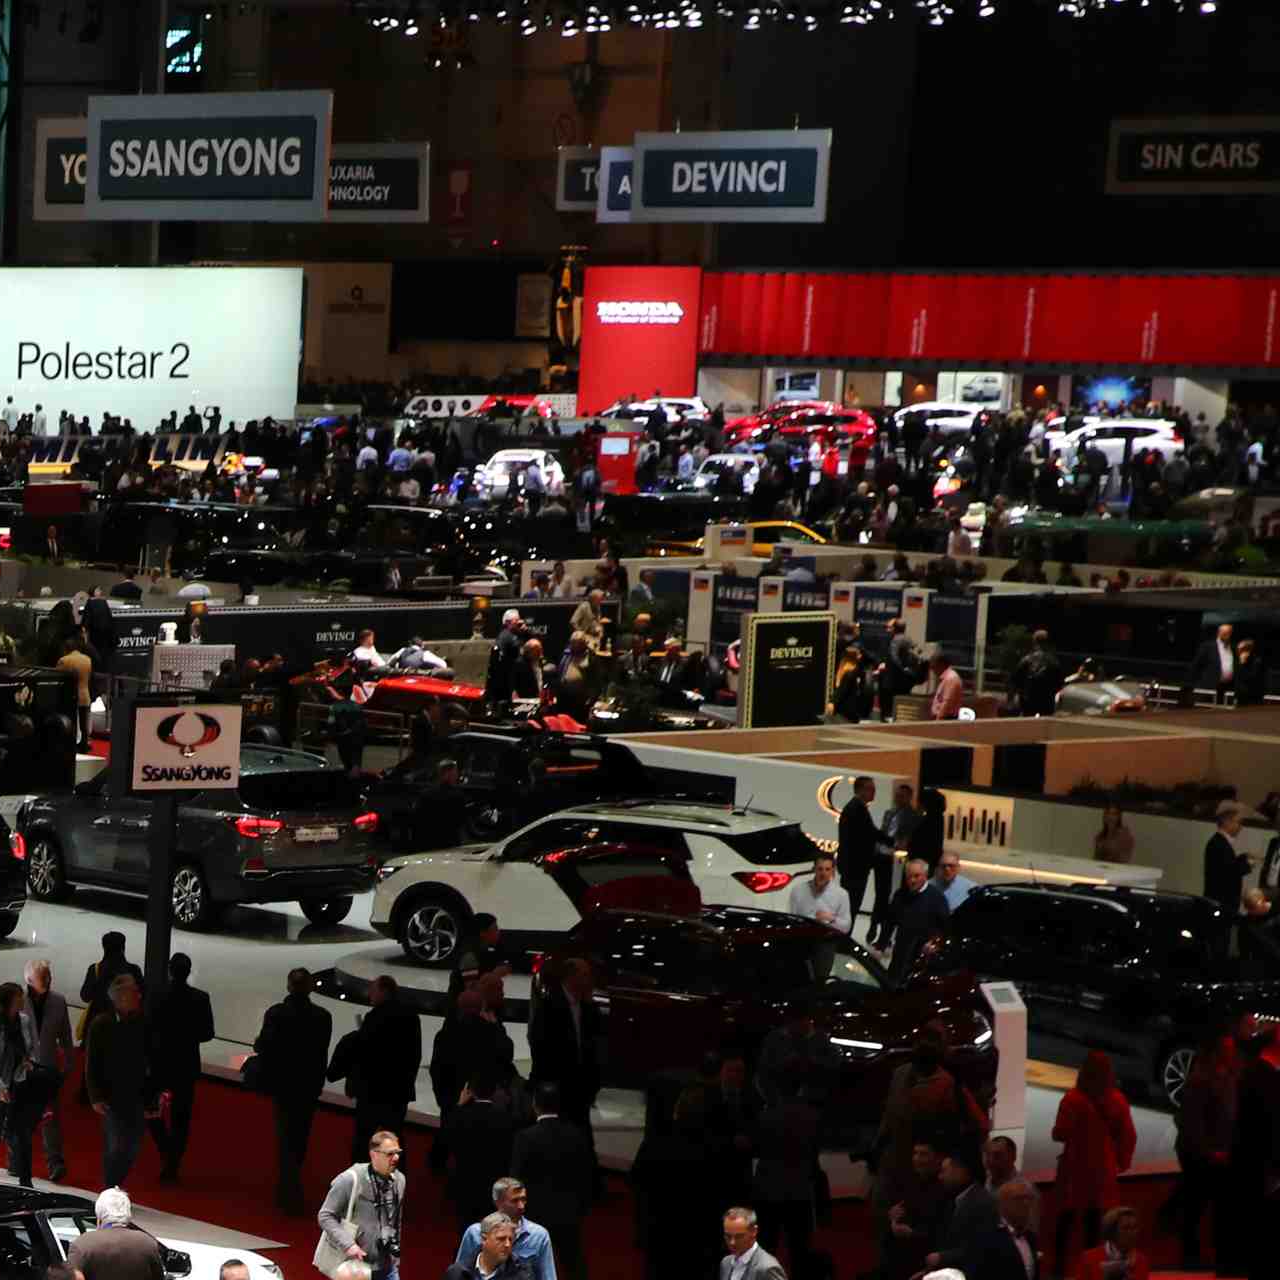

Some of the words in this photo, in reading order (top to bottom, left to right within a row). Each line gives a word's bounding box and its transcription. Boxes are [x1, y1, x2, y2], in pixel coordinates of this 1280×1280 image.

[108, 137, 302, 178] SSANGYONG
[1140, 143, 1184, 169] SIN
[1191, 142, 1261, 169] CARS
[329, 165, 375, 182] UXARIA
[671, 160, 787, 193] DEVINCI
[18, 341, 163, 380] Polestar
[169, 342, 190, 379] 2
[770, 646, 813, 659] DEVINCI
